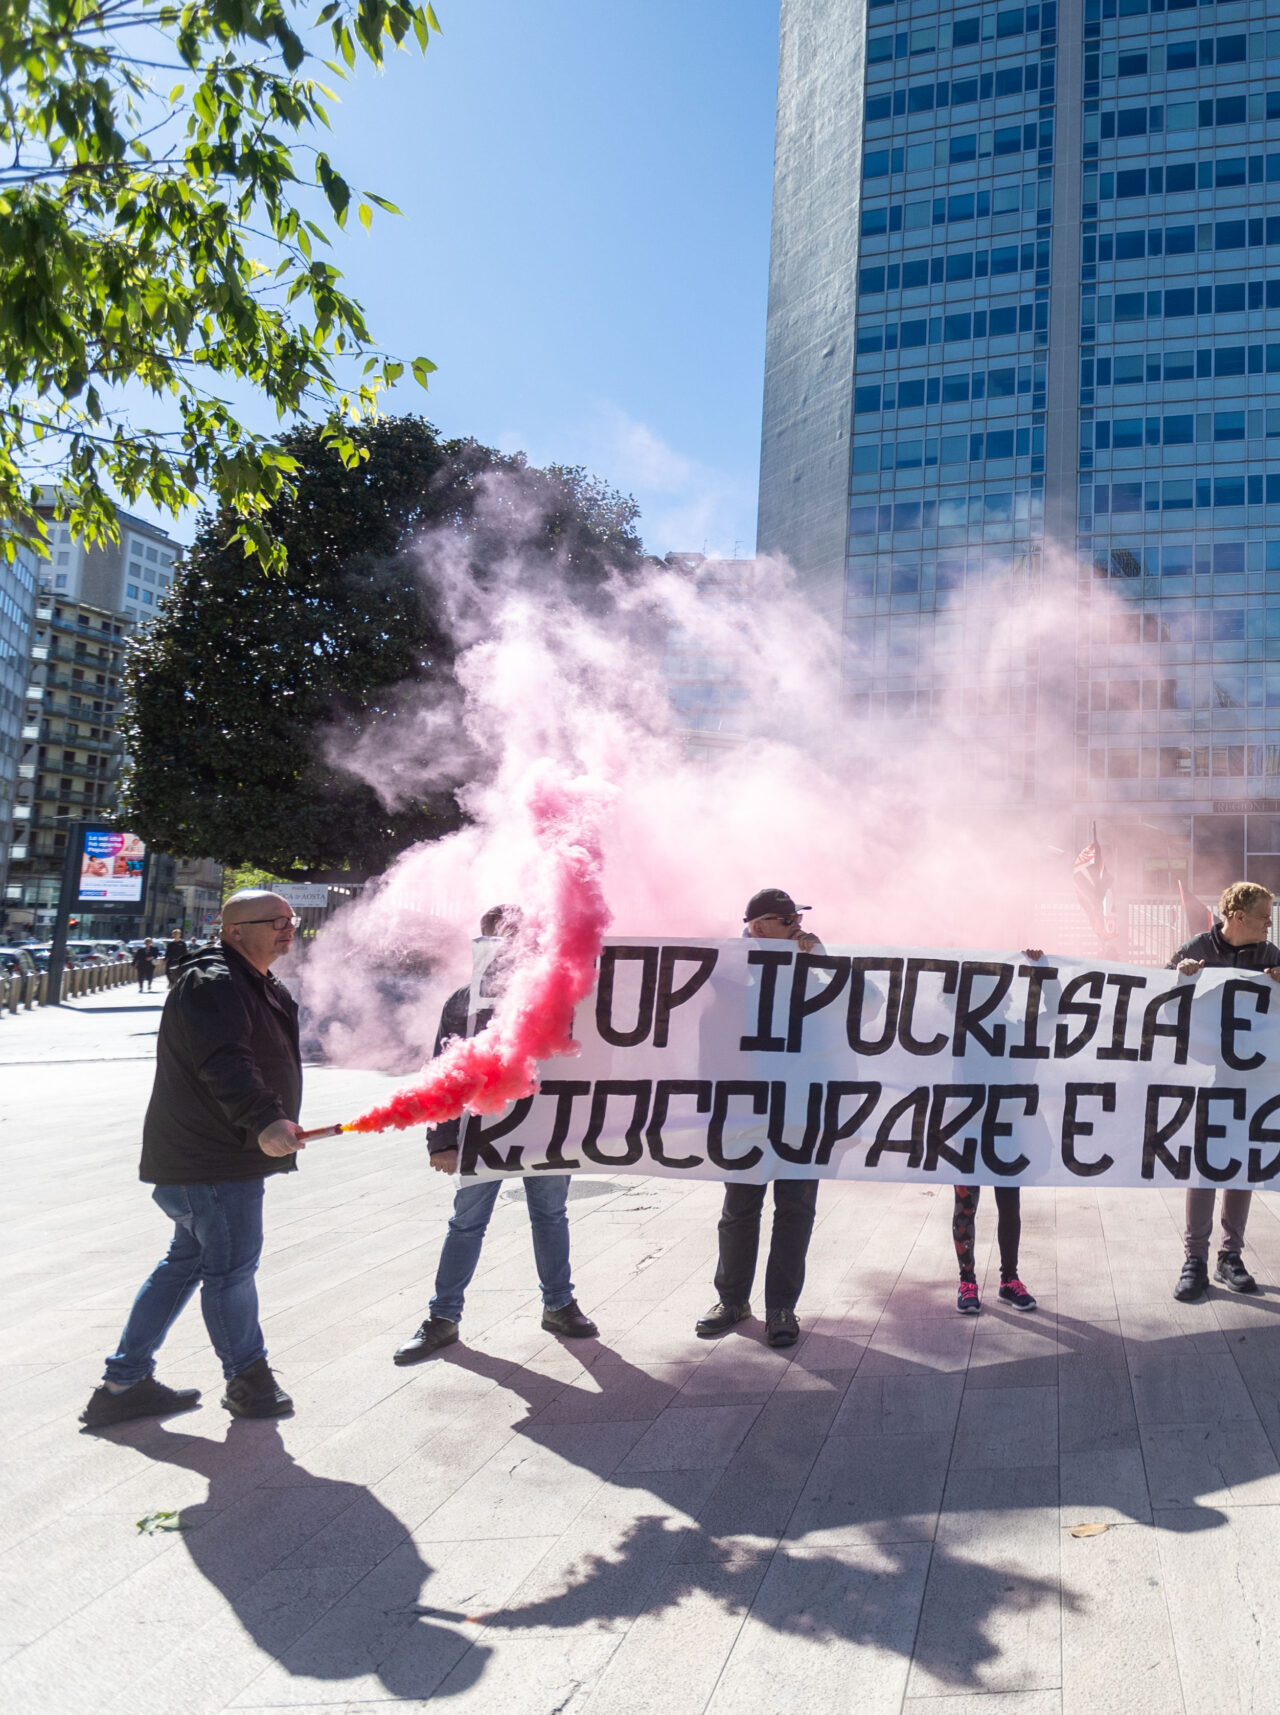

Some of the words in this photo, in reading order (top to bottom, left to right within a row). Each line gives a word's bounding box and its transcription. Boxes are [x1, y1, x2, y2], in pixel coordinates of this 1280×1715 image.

[740, 951, 1189, 1062] IPOCRISIA
[1221, 979, 1271, 1071] E
[460, 1080, 1038, 1176] RIOCCUPARE
[1062, 1082, 1116, 1177] E
